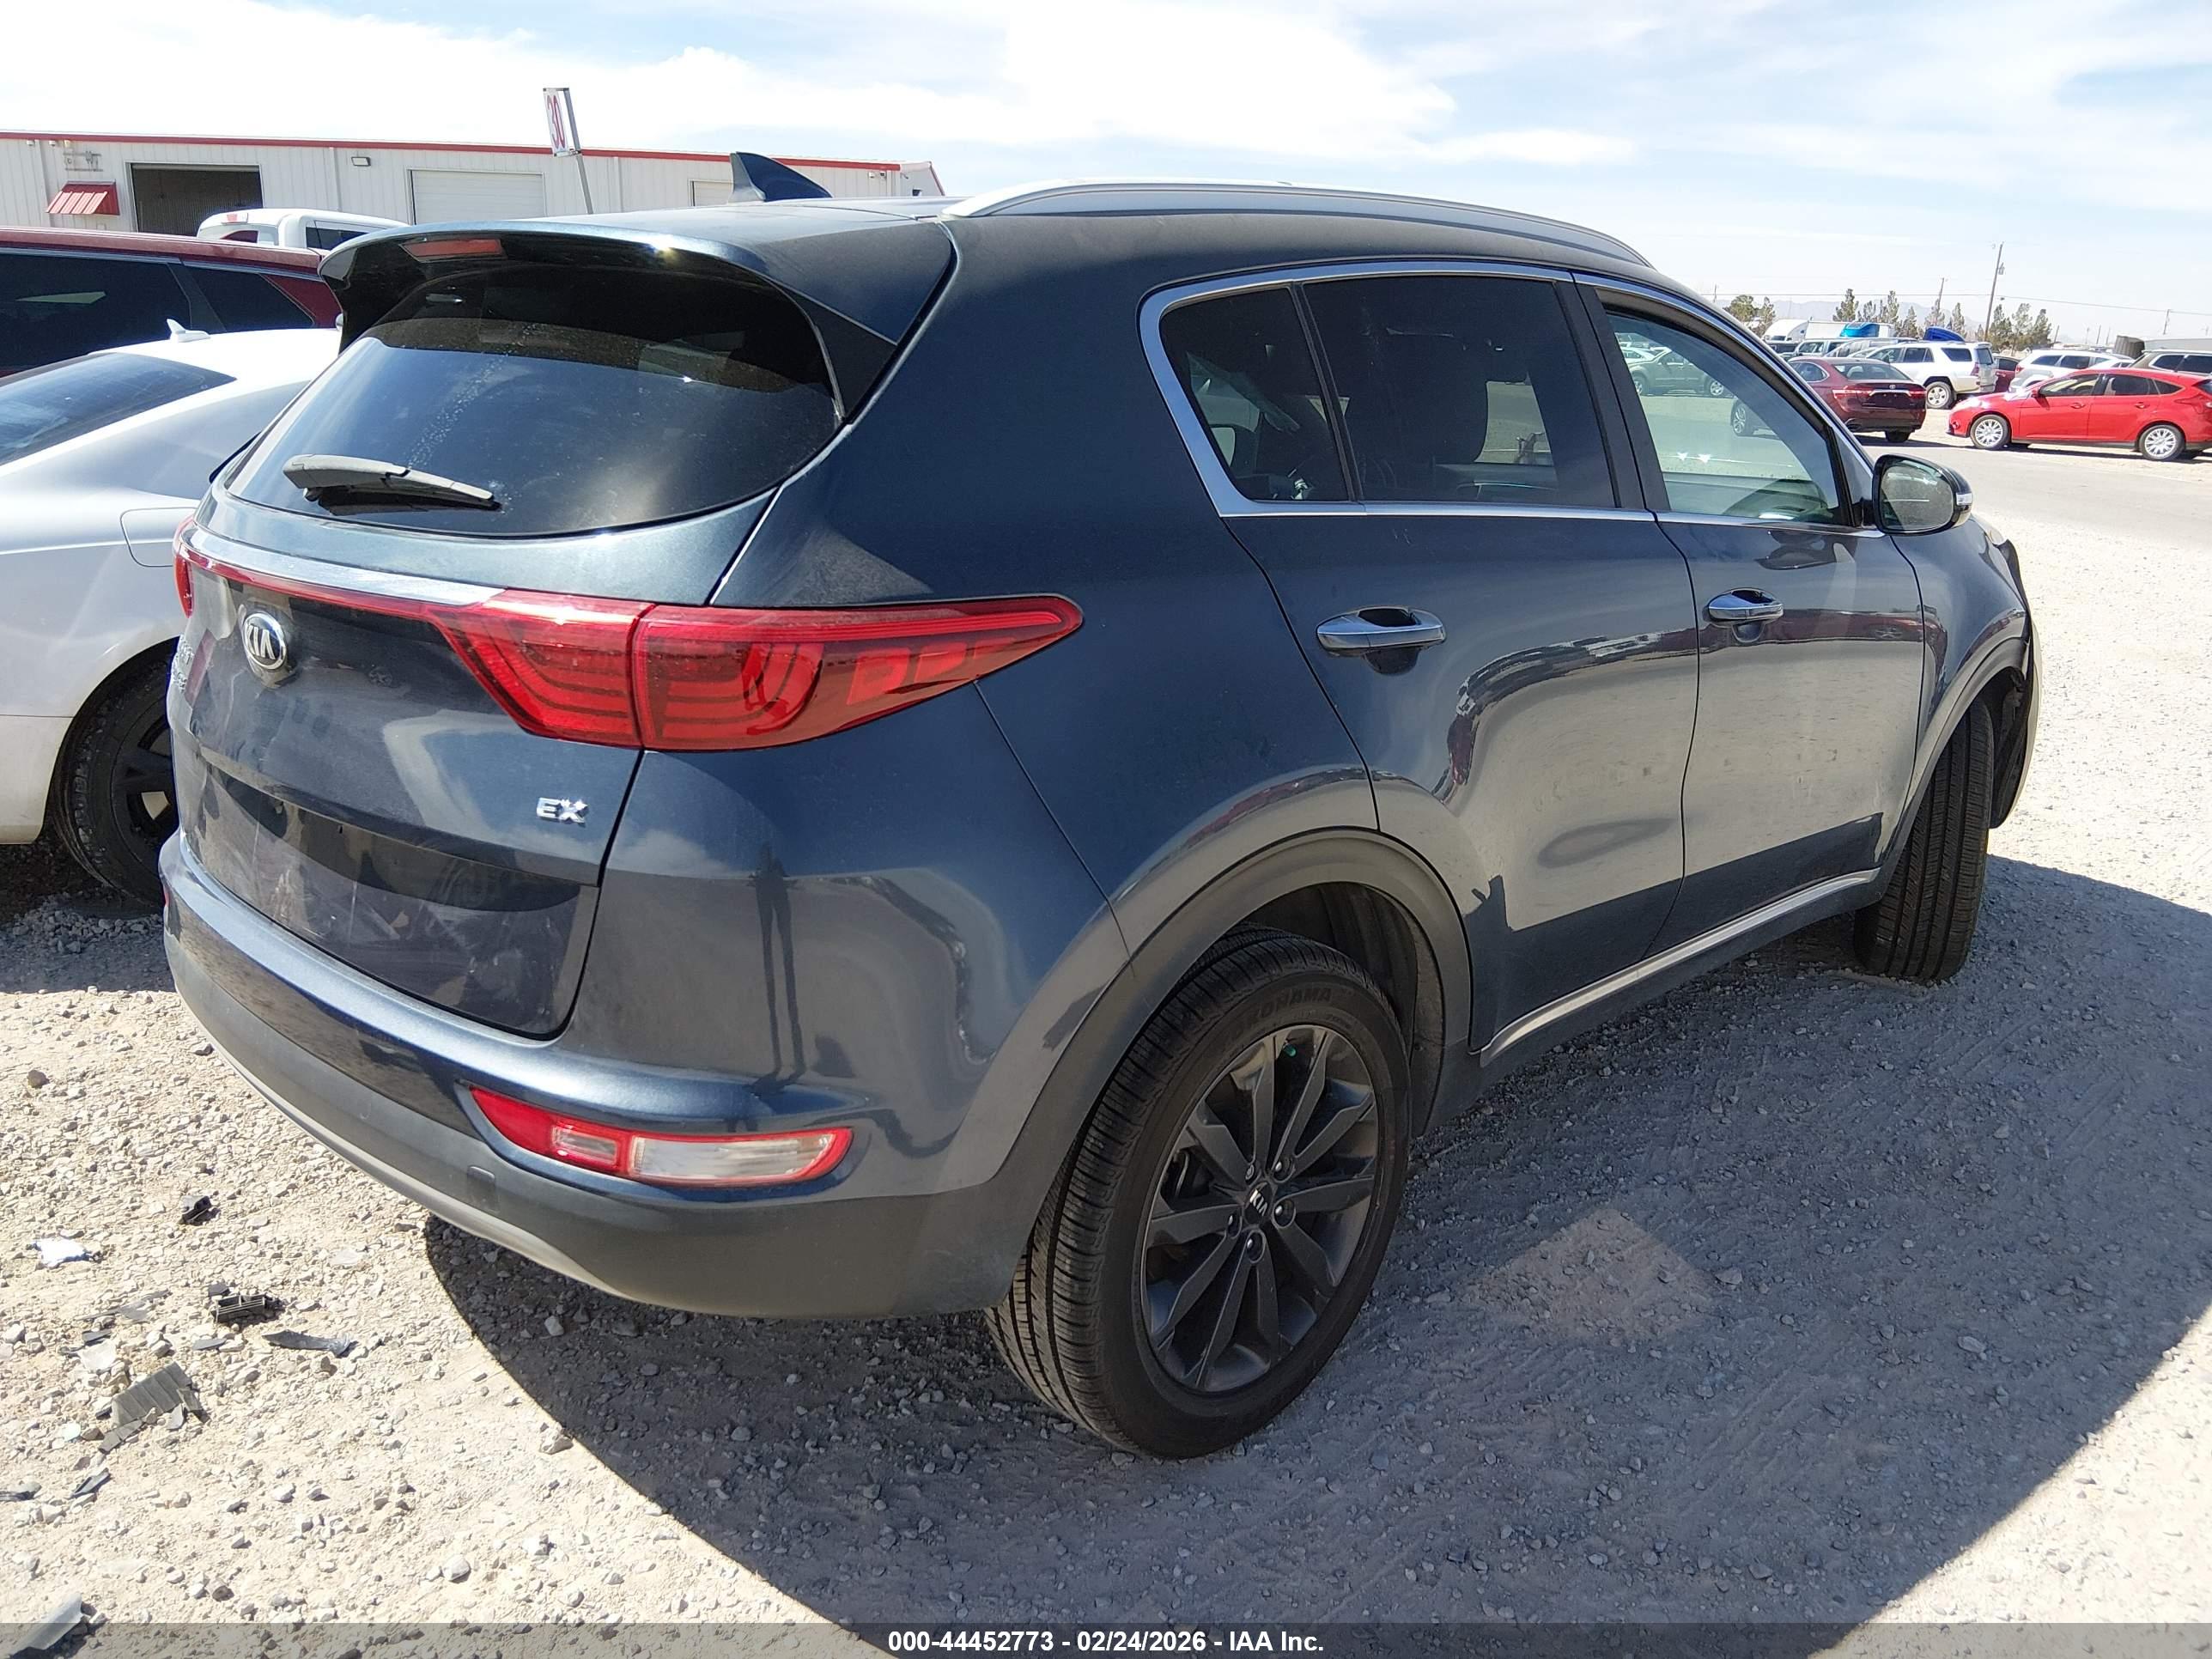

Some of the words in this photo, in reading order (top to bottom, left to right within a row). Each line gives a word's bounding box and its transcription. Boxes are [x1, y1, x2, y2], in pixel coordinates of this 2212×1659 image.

[546, 94, 565, 149] 30
[246, 624, 276, 660] KIA
[537, 797, 587, 823] EX
[1250, 1188, 1268, 1216] KIA
